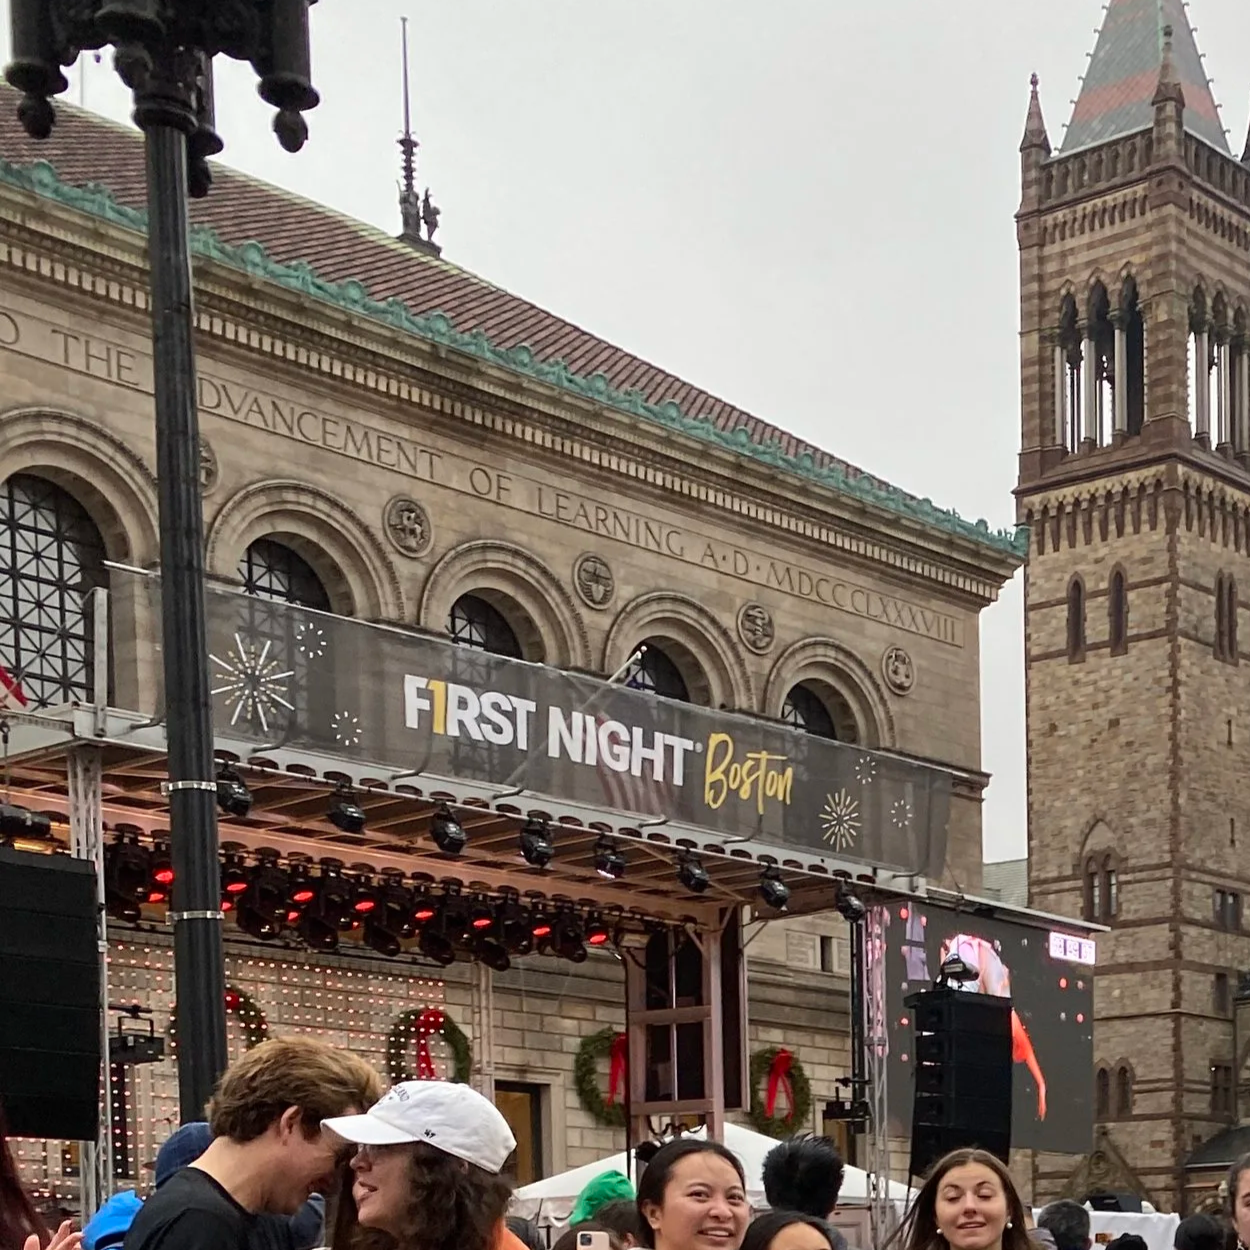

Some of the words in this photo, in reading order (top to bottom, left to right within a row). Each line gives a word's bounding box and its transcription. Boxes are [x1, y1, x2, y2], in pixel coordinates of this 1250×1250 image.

[0, 311, 20, 345] O
[51, 329, 140, 386] THE
[198, 376, 442, 480] DVANCEMENT
[469, 467, 512, 500] OF
[536, 487, 684, 558] LEARNING
[547, 705, 695, 787] NIGHT
[705, 732, 793, 815] Boston
